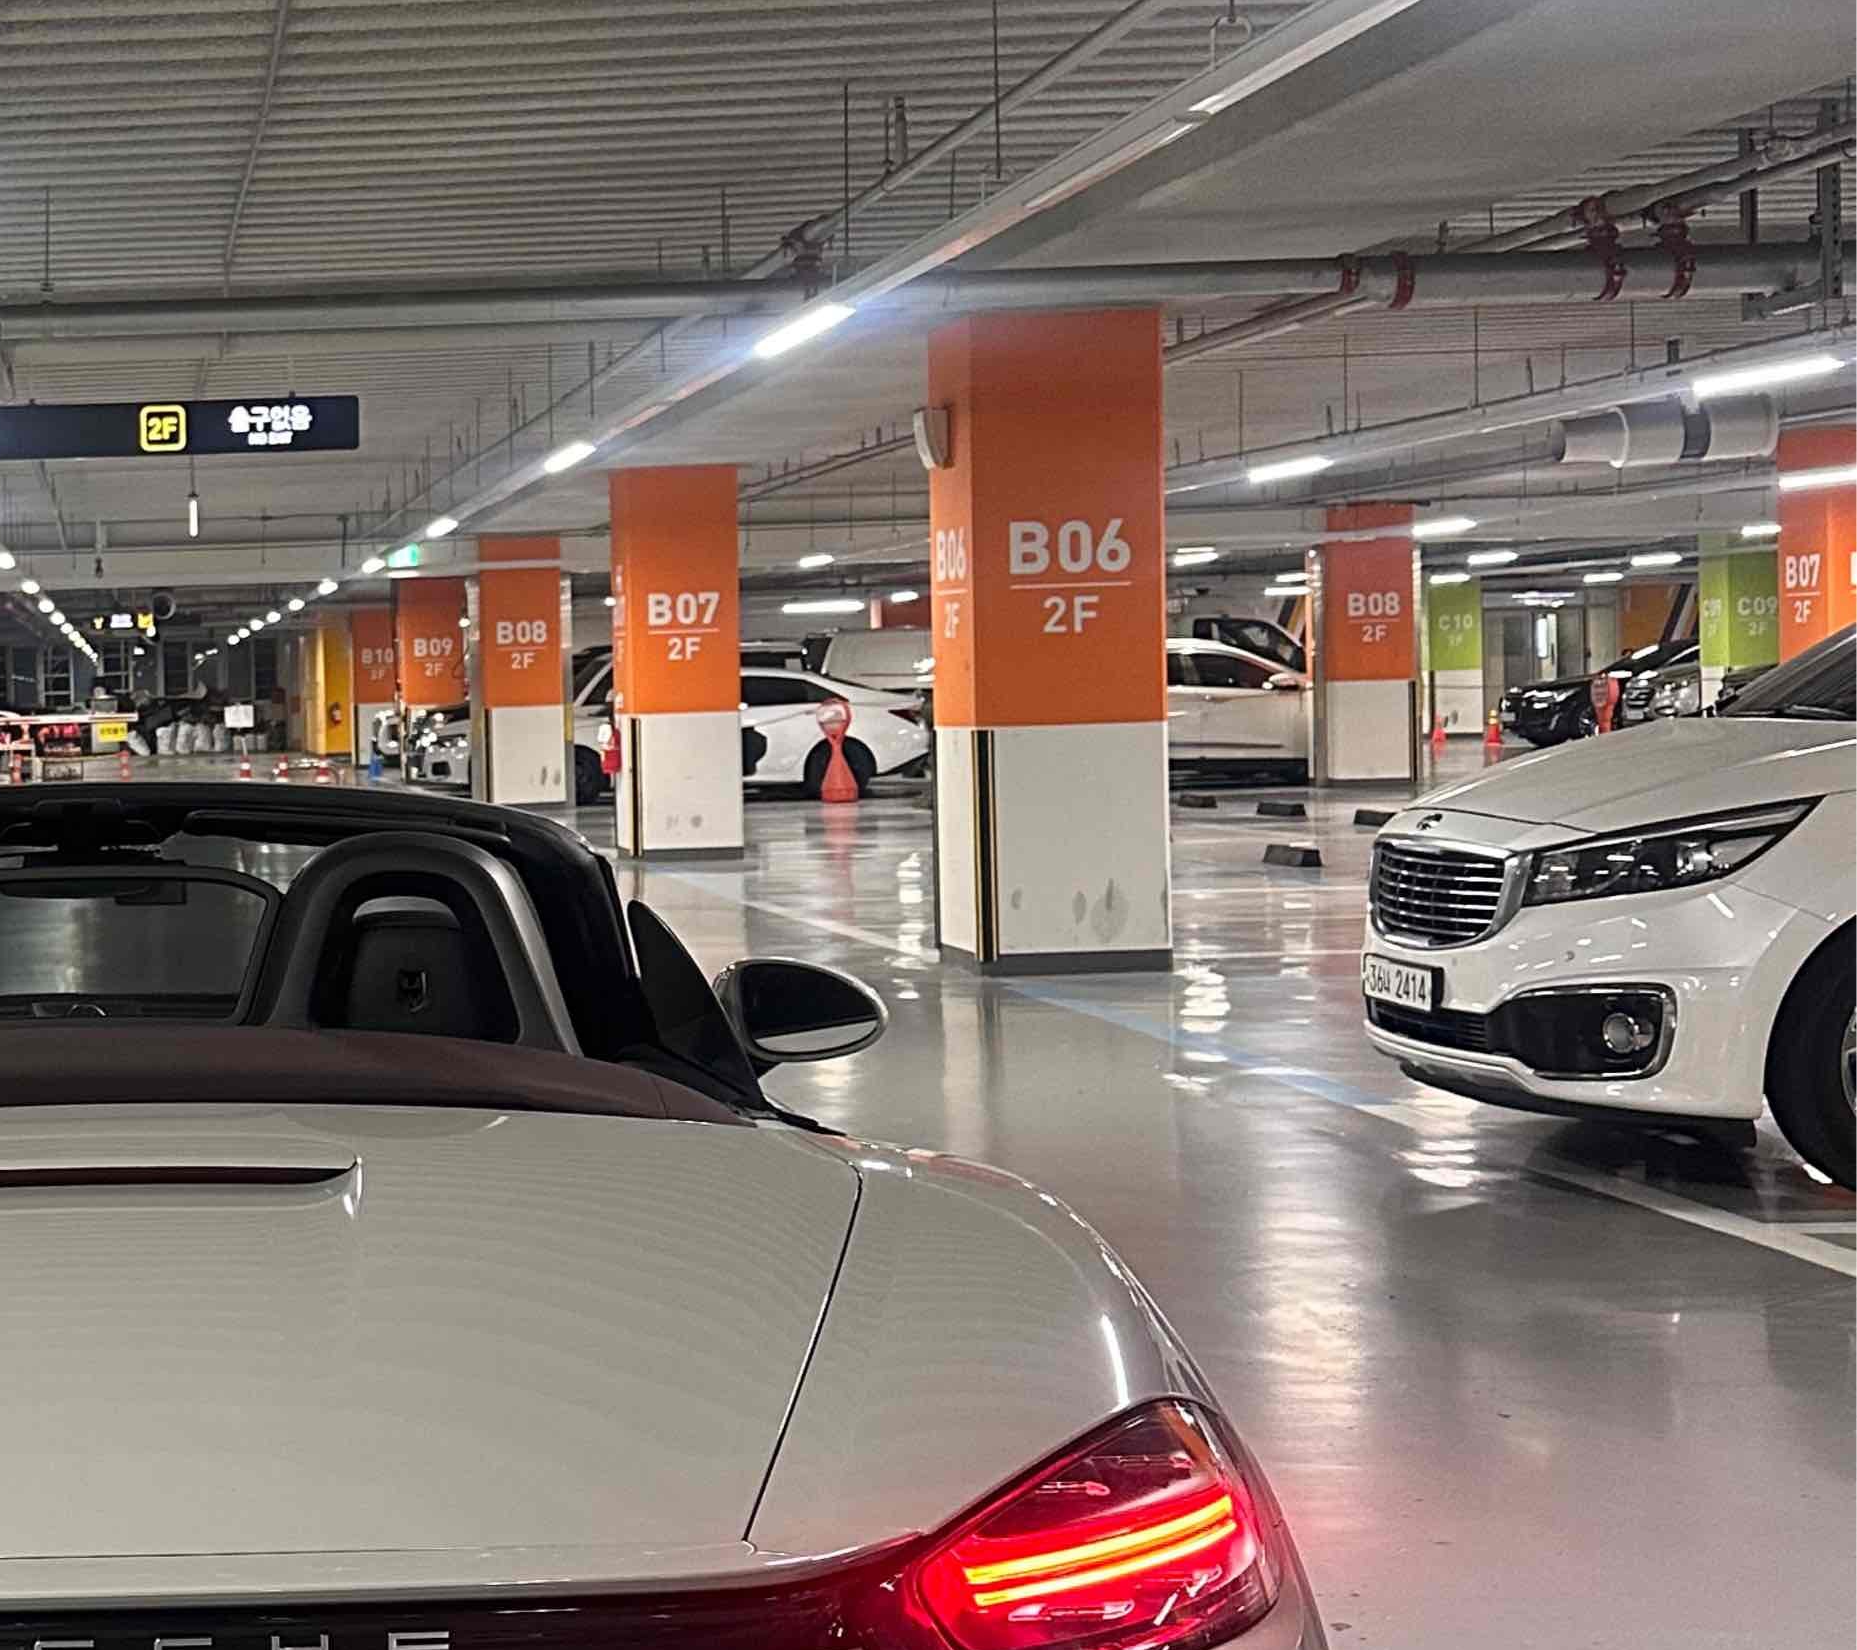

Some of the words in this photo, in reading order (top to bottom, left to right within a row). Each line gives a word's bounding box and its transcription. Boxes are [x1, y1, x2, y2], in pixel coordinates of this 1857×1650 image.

[147, 417, 179, 441] 2F
[935, 528, 966, 582] B06
[1009, 518, 1131, 575] B06
[1785, 553, 1821, 589] B07
[647, 592, 720, 626] B07
[1043, 595, 1099, 633] 2F
[1347, 591, 1400, 617] B08
[1794, 601, 1812, 623] 2F
[496, 620, 547, 645] B08
[944, 602, 960, 639] 2F
[1362, 625, 1388, 643] 2F
[414, 637, 453, 657] B09
[668, 637, 701, 661] 2F
[425, 662, 444, 677] 2F
[511, 652, 535, 669] 2F
[1395, 969, 1427, 1003] 2414
